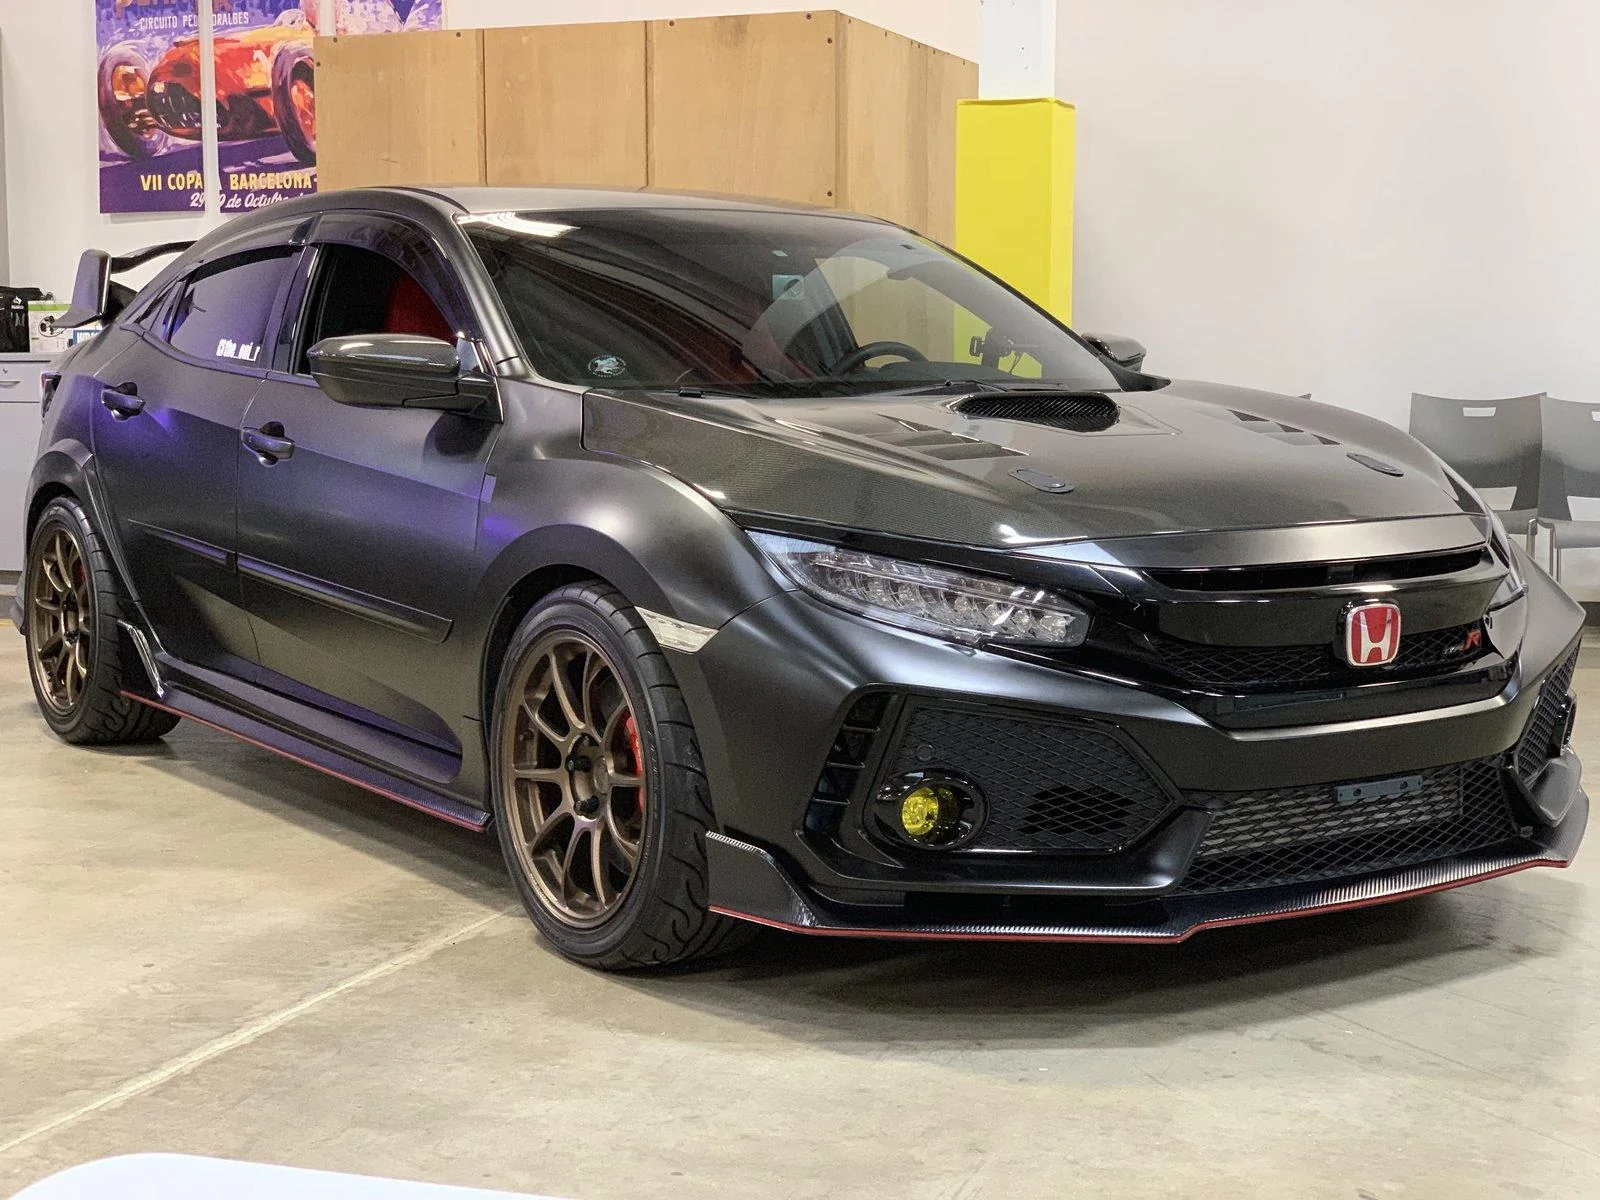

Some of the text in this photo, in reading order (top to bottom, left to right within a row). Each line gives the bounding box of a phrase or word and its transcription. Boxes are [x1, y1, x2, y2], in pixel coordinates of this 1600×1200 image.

[140, 15, 178, 29] CIRCUITO
[140, 174, 162, 191] VII
[167, 173, 203, 191] COPA
[229, 172, 312, 190] BARCELONA
[225, 193, 242, 208] de
